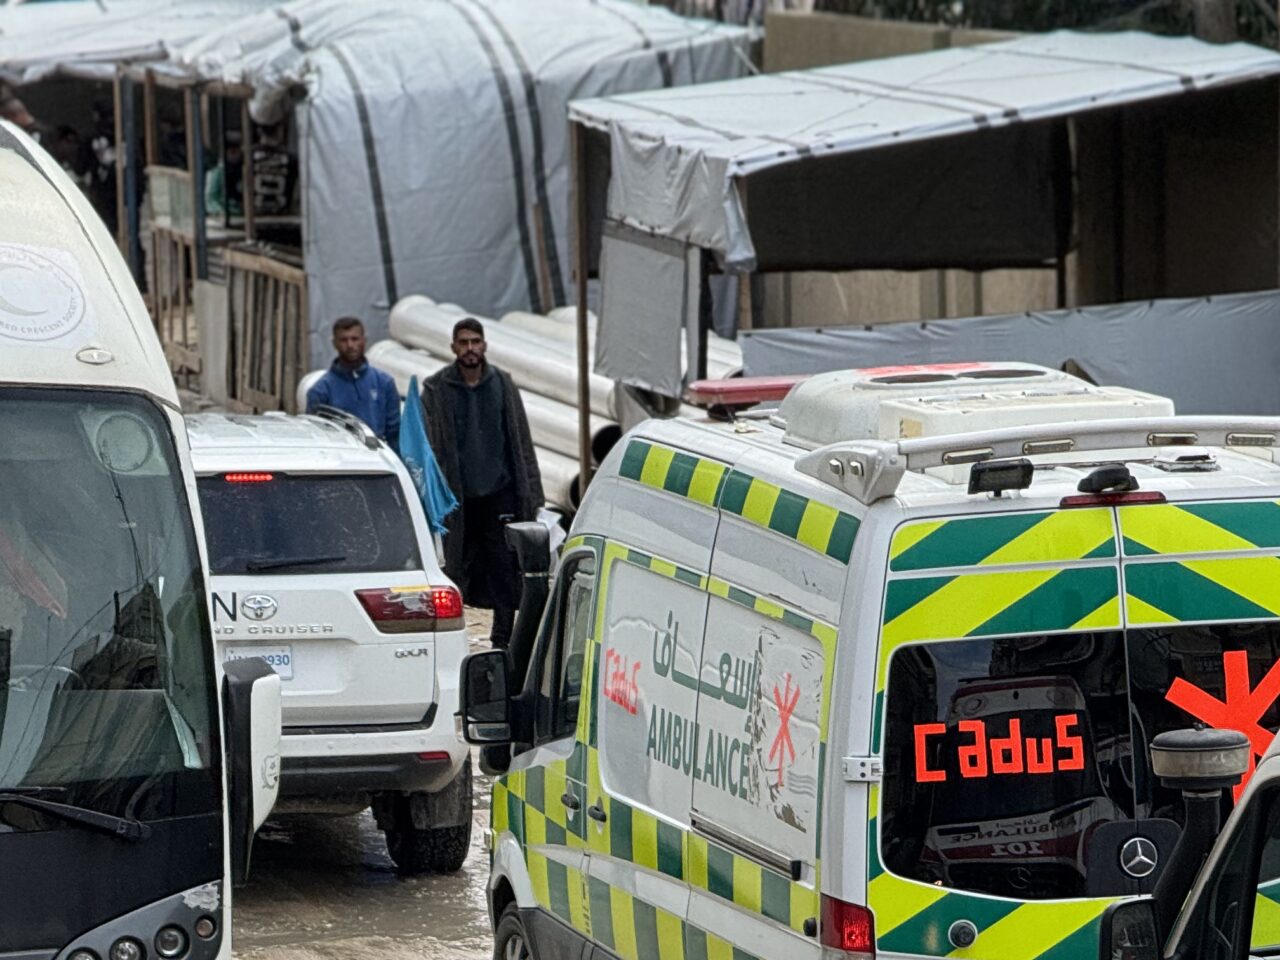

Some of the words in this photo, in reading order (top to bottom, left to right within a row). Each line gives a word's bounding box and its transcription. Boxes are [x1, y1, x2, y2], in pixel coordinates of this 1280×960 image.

[211, 591, 237, 622] N
[247, 624, 334, 635] CRUISER
[646, 703, 750, 802] AMBULANCE
